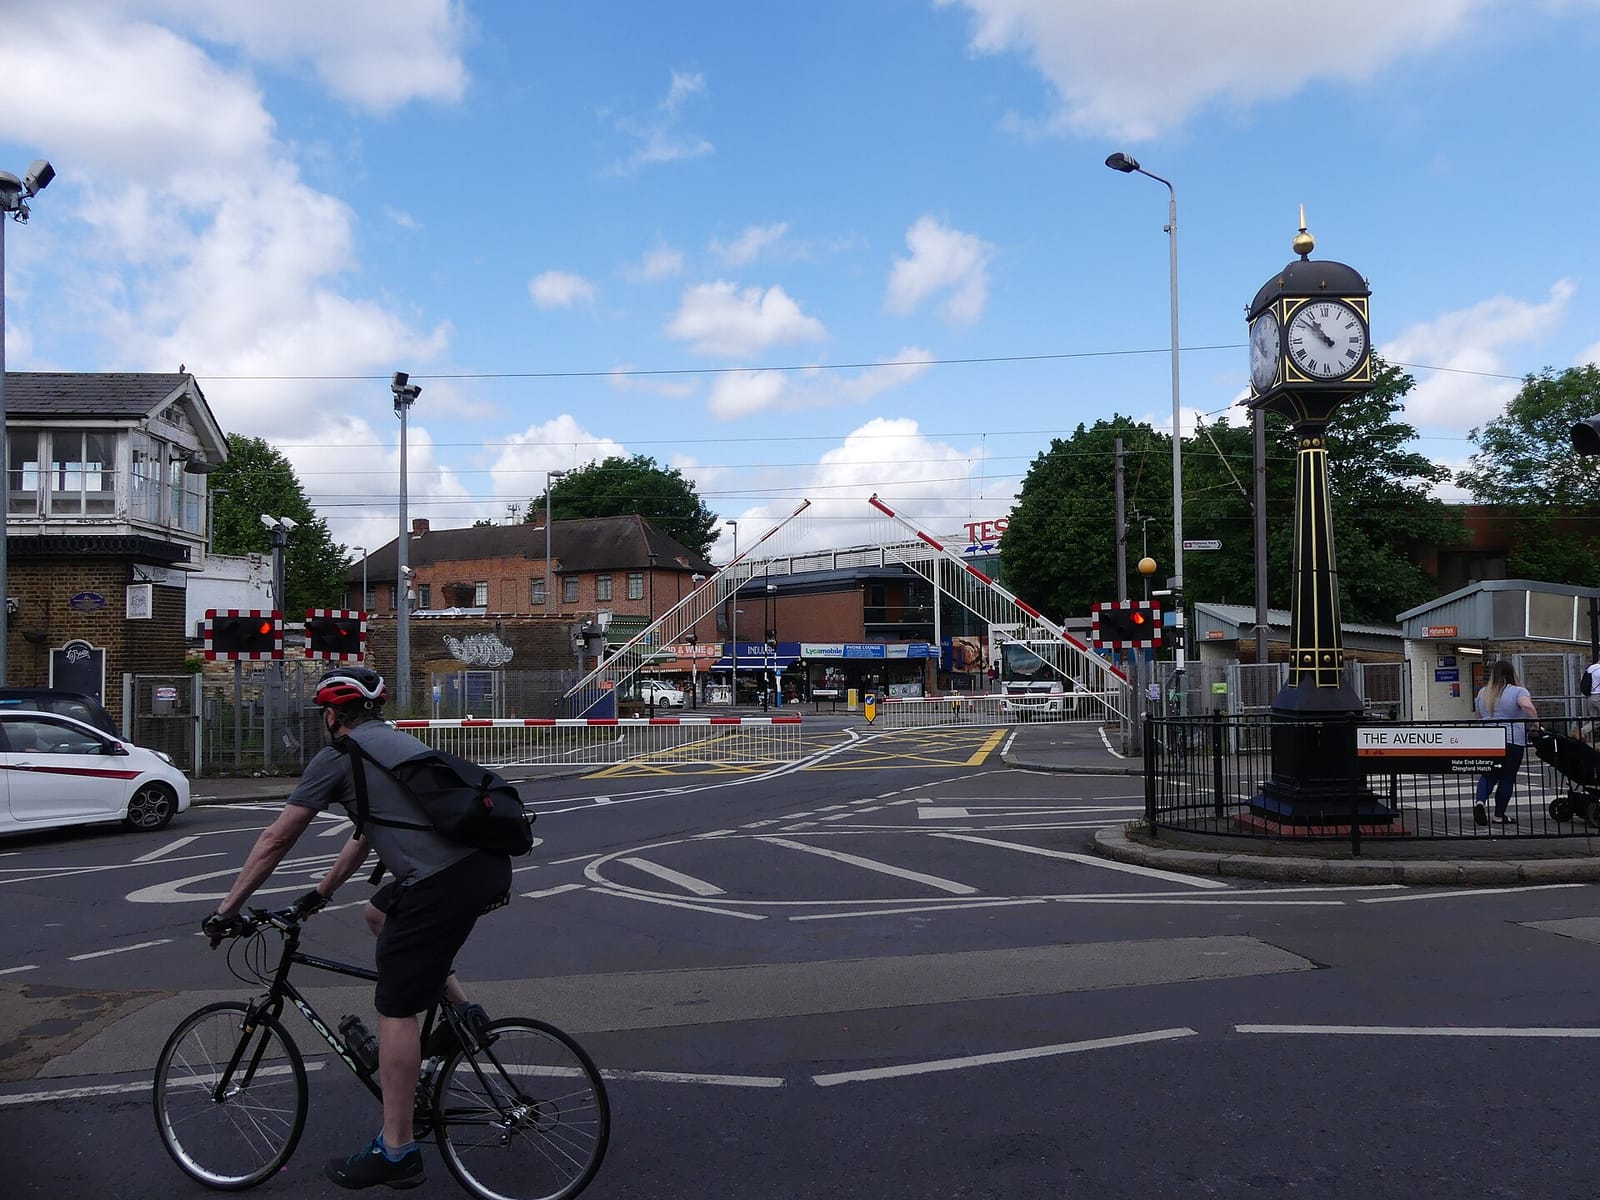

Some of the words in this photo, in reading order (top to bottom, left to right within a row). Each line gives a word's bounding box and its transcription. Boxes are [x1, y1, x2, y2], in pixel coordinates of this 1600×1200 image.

[805, 647, 843, 656] Lycamobile
[1363, 733, 1387, 744] THE
[1393, 733, 1443, 744] AVENUE
